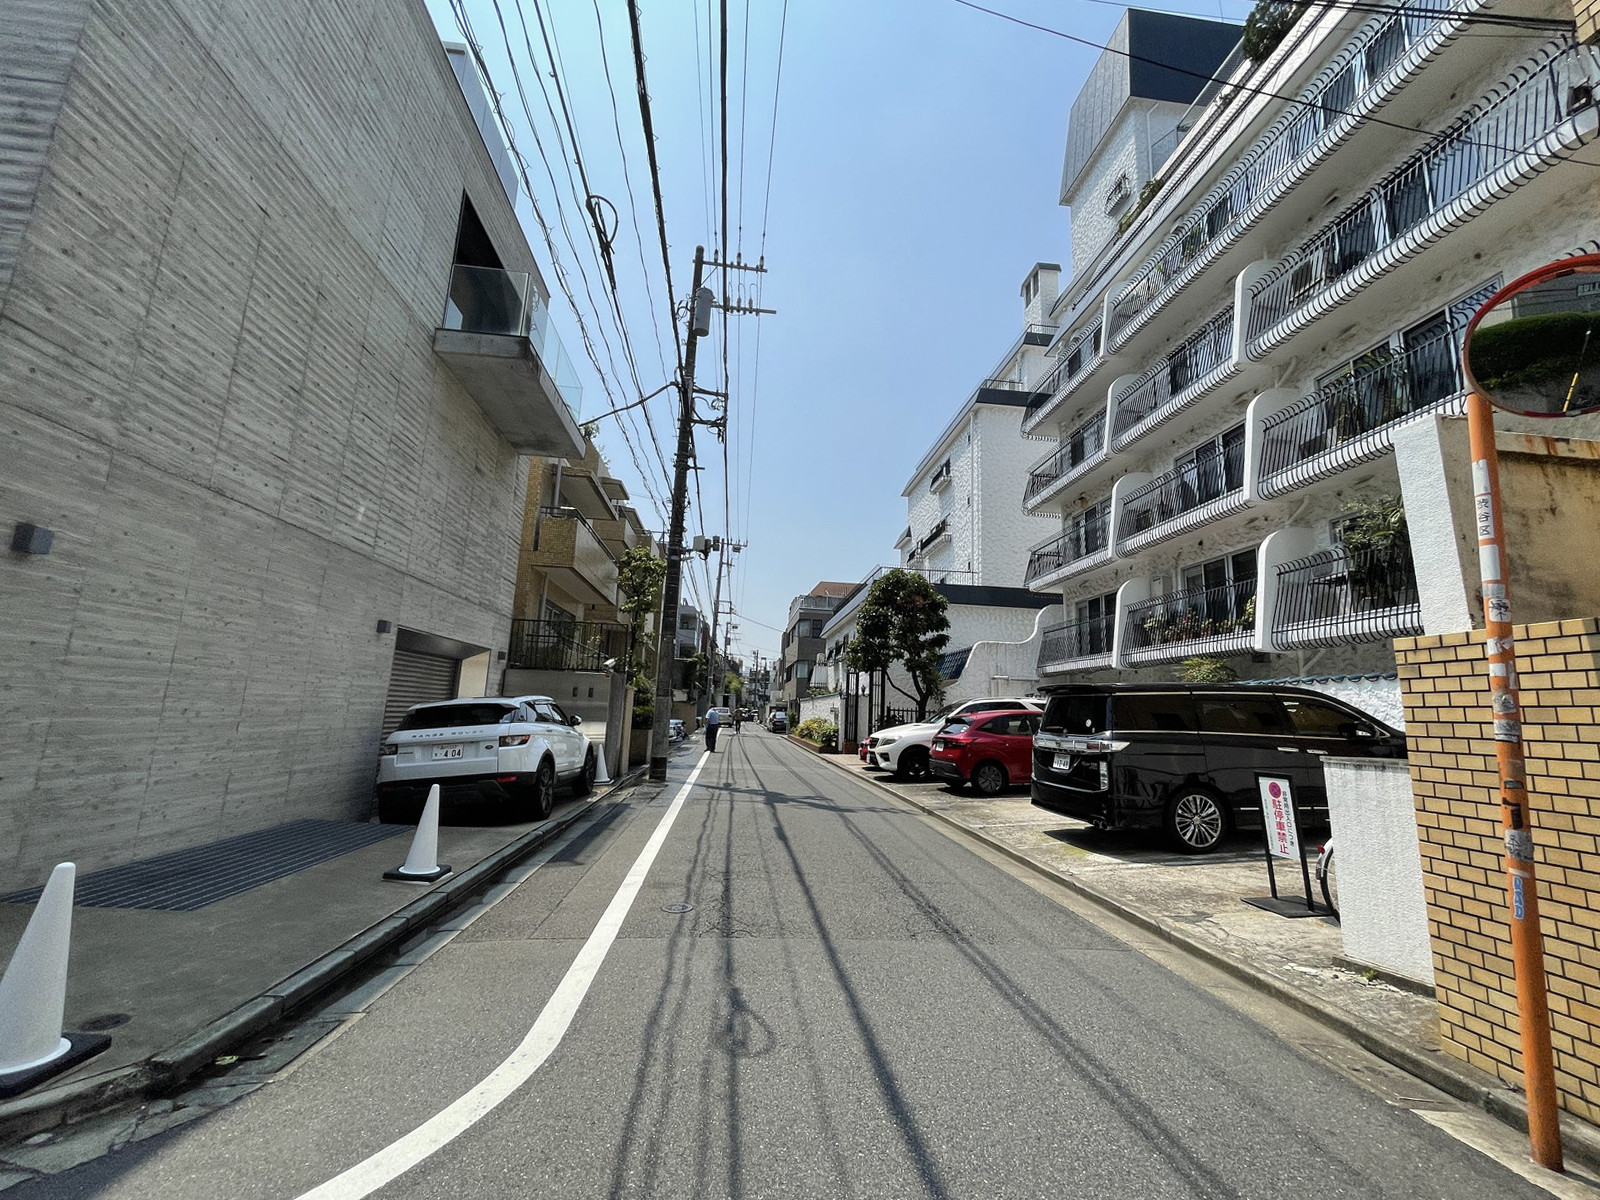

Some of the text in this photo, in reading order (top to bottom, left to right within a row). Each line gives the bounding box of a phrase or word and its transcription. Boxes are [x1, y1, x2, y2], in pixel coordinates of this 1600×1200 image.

[1476, 497, 1491, 536] 渋谷区
[1272, 799, 1289, 855] 駐停車禁止
